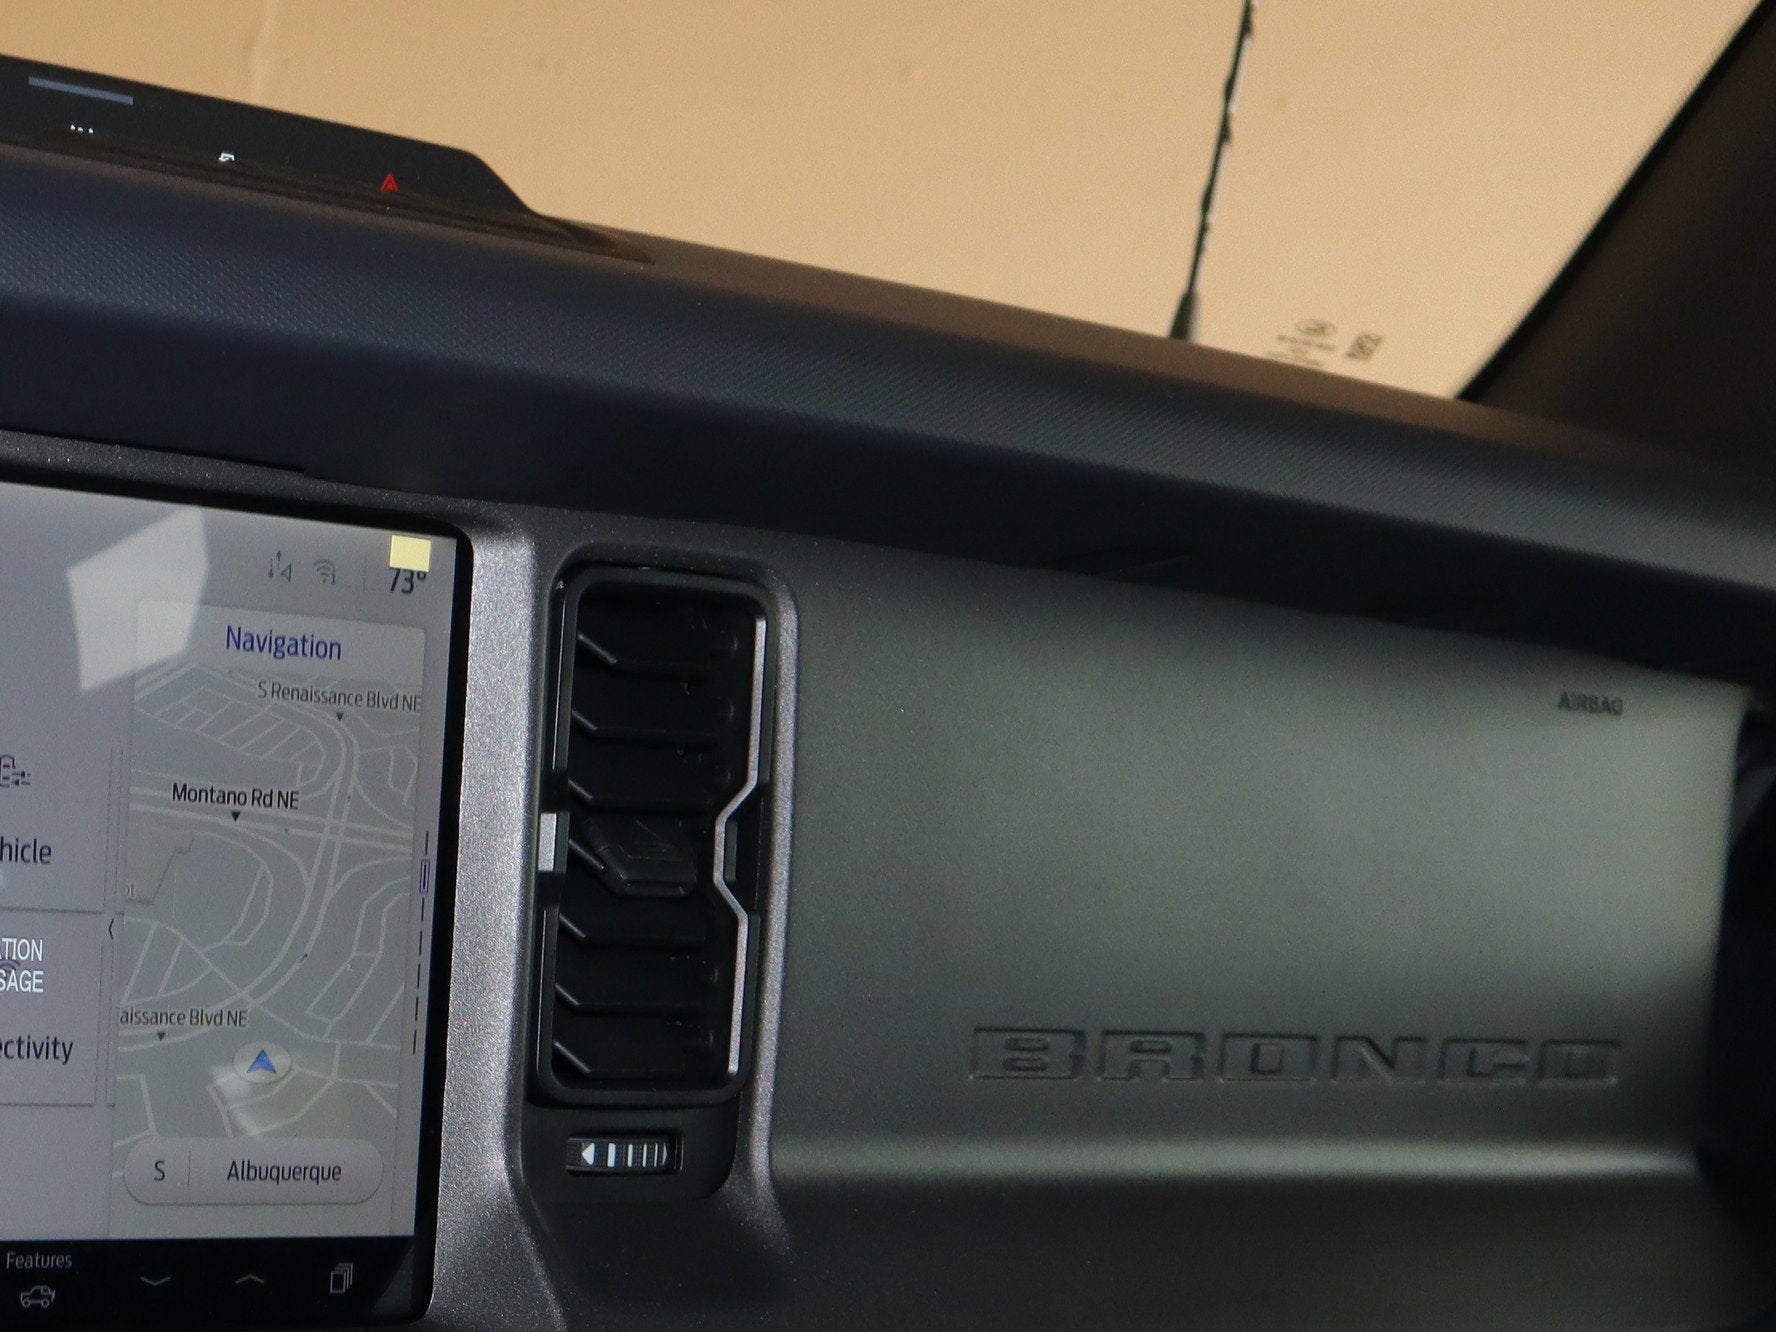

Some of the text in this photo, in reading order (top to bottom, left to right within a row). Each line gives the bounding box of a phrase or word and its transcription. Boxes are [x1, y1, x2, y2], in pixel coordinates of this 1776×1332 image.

[225, 624, 342, 661] Navigation
[257, 680, 268, 699] S
[271, 683, 364, 707] Renaissance
[366, 691, 399, 710] Blvd
[171, 782, 300, 810] Montano Rd NE
[120, 1007, 248, 1028] aissance Blvd NE
[969, 1027, 1622, 1087] BRONCO
[153, 1160, 166, 1182] S
[227, 1160, 342, 1185] Albuquerque
[6, 1251, 72, 1270] Features
